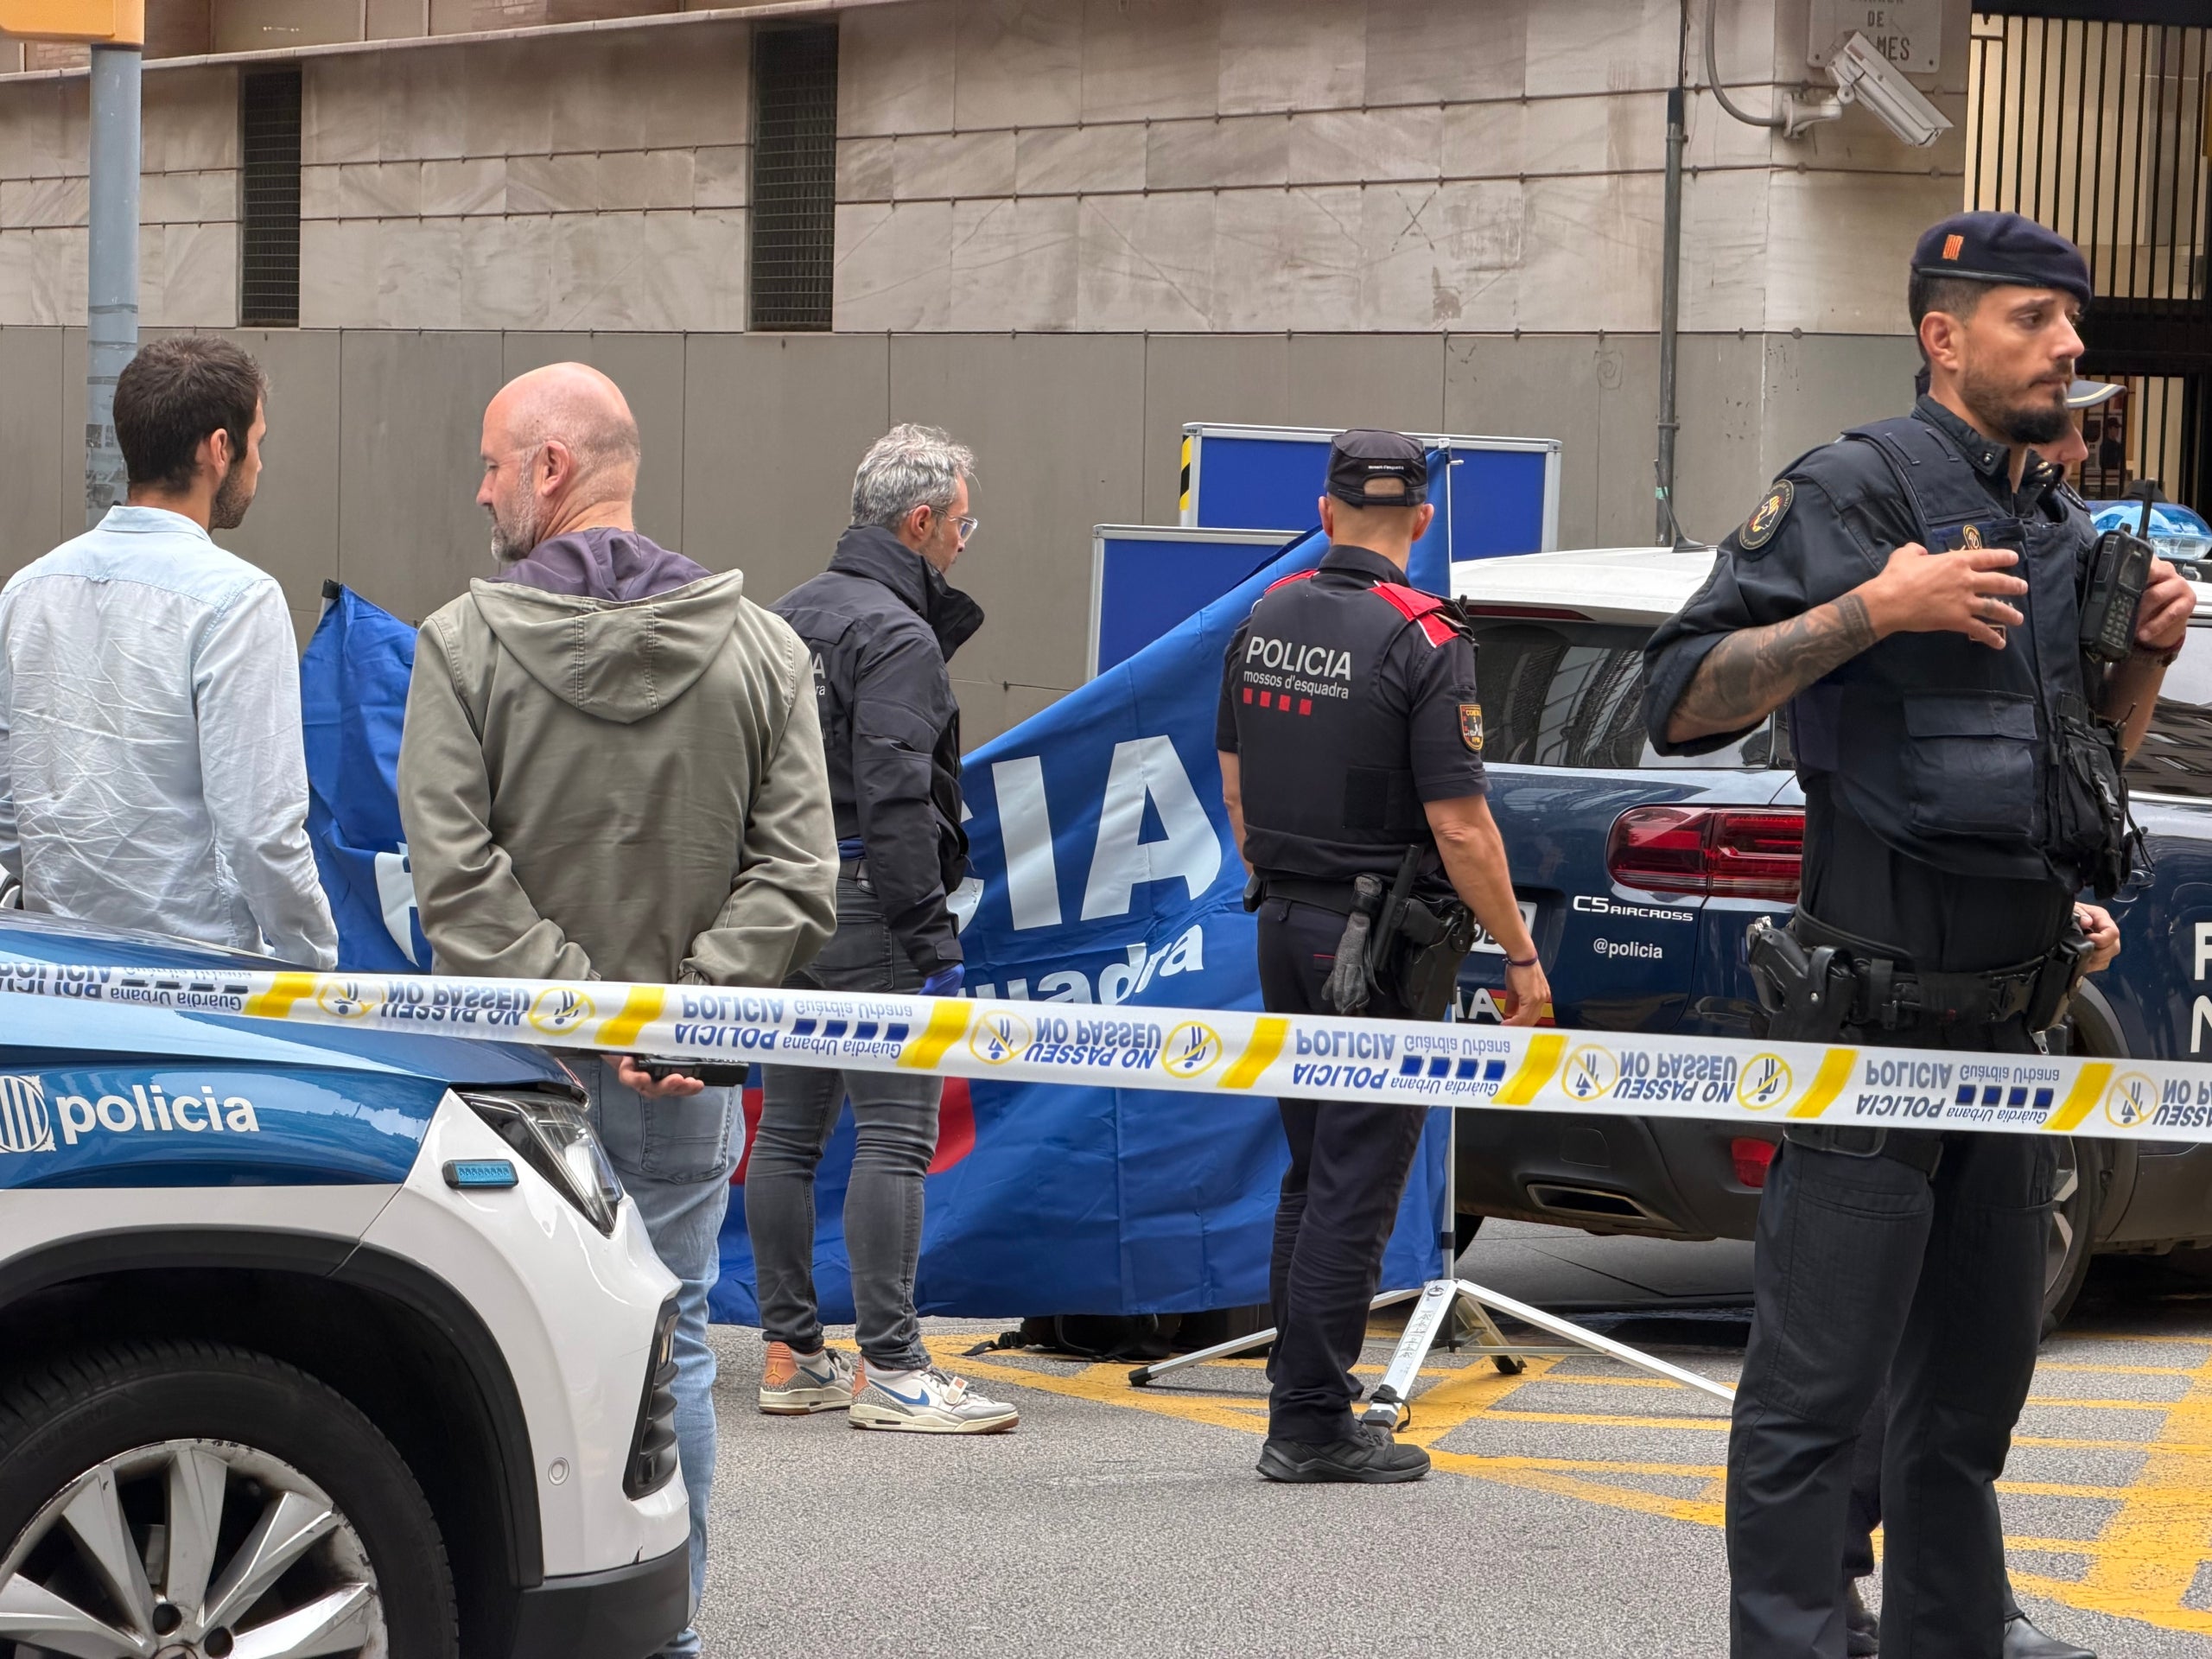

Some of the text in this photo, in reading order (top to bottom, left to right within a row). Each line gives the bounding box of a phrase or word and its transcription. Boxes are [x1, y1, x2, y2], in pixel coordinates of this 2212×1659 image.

[1867, 10, 1885, 28] DE
[1866, 35, 1910, 60] MES
[1245, 636, 1351, 681] POLICIA
[1243, 670, 1349, 699] mossos d'esquadra
[1573, 895, 1694, 922] C5 AIRCROSS
[1593, 938, 1662, 960] @policia
[111, 988, 172, 1006] Urbana
[675, 1024, 779, 1050] POLICIA
[783, 1035, 902, 1058] Guàrdia Urbana
[1024, 1043, 1158, 1069] NO PASSEU
[1294, 1063, 1389, 1090] POLICIA
[1391, 1076, 1499, 1097] Guàrdia Urbana
[1612, 1077, 1735, 1103] NO PASSEU
[55, 1084, 259, 1145] policia
[1856, 1093, 1946, 1118] POLICIA
[1947, 1104, 2047, 1125] Guàrdia Urbana
